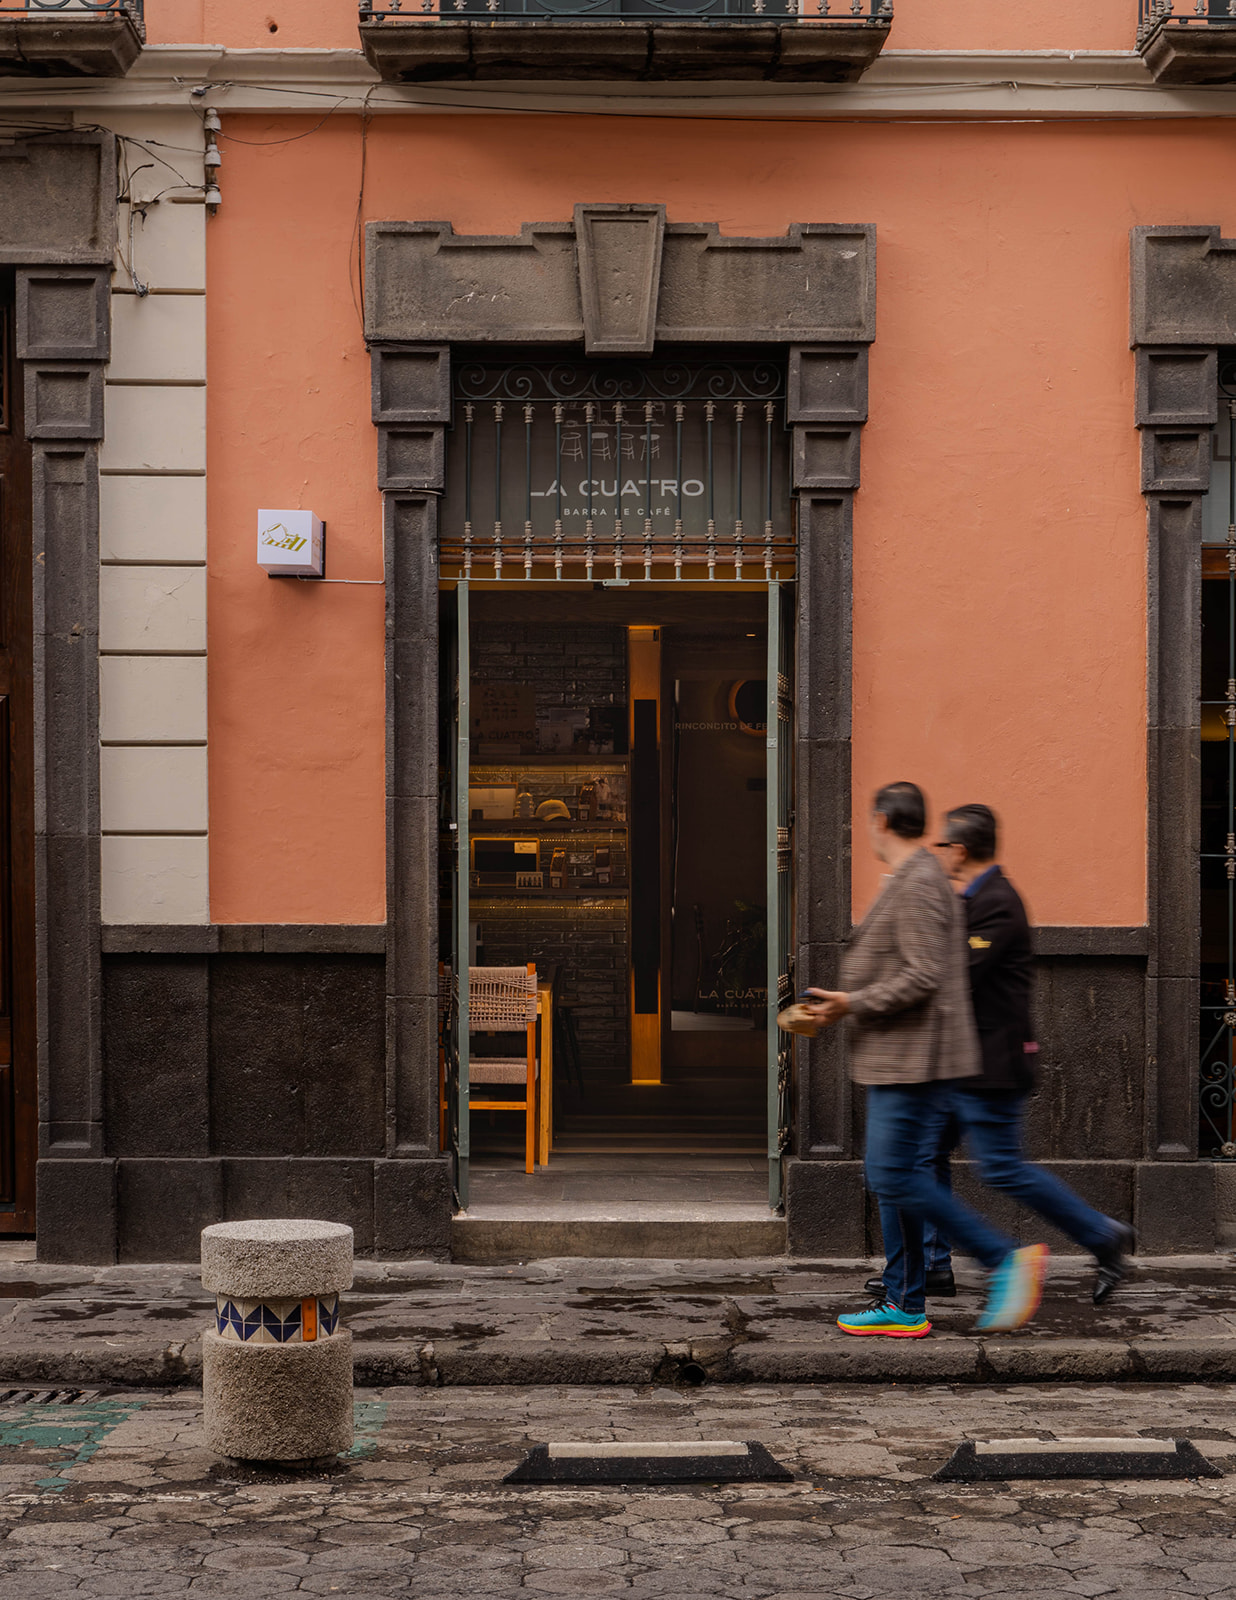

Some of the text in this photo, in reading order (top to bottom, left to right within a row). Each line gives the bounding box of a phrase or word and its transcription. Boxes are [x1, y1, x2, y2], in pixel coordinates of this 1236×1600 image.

[578, 479, 705, 497] CUATRO
[563, 508, 608, 516] BARRA
[698, 989, 720, 999] LA
